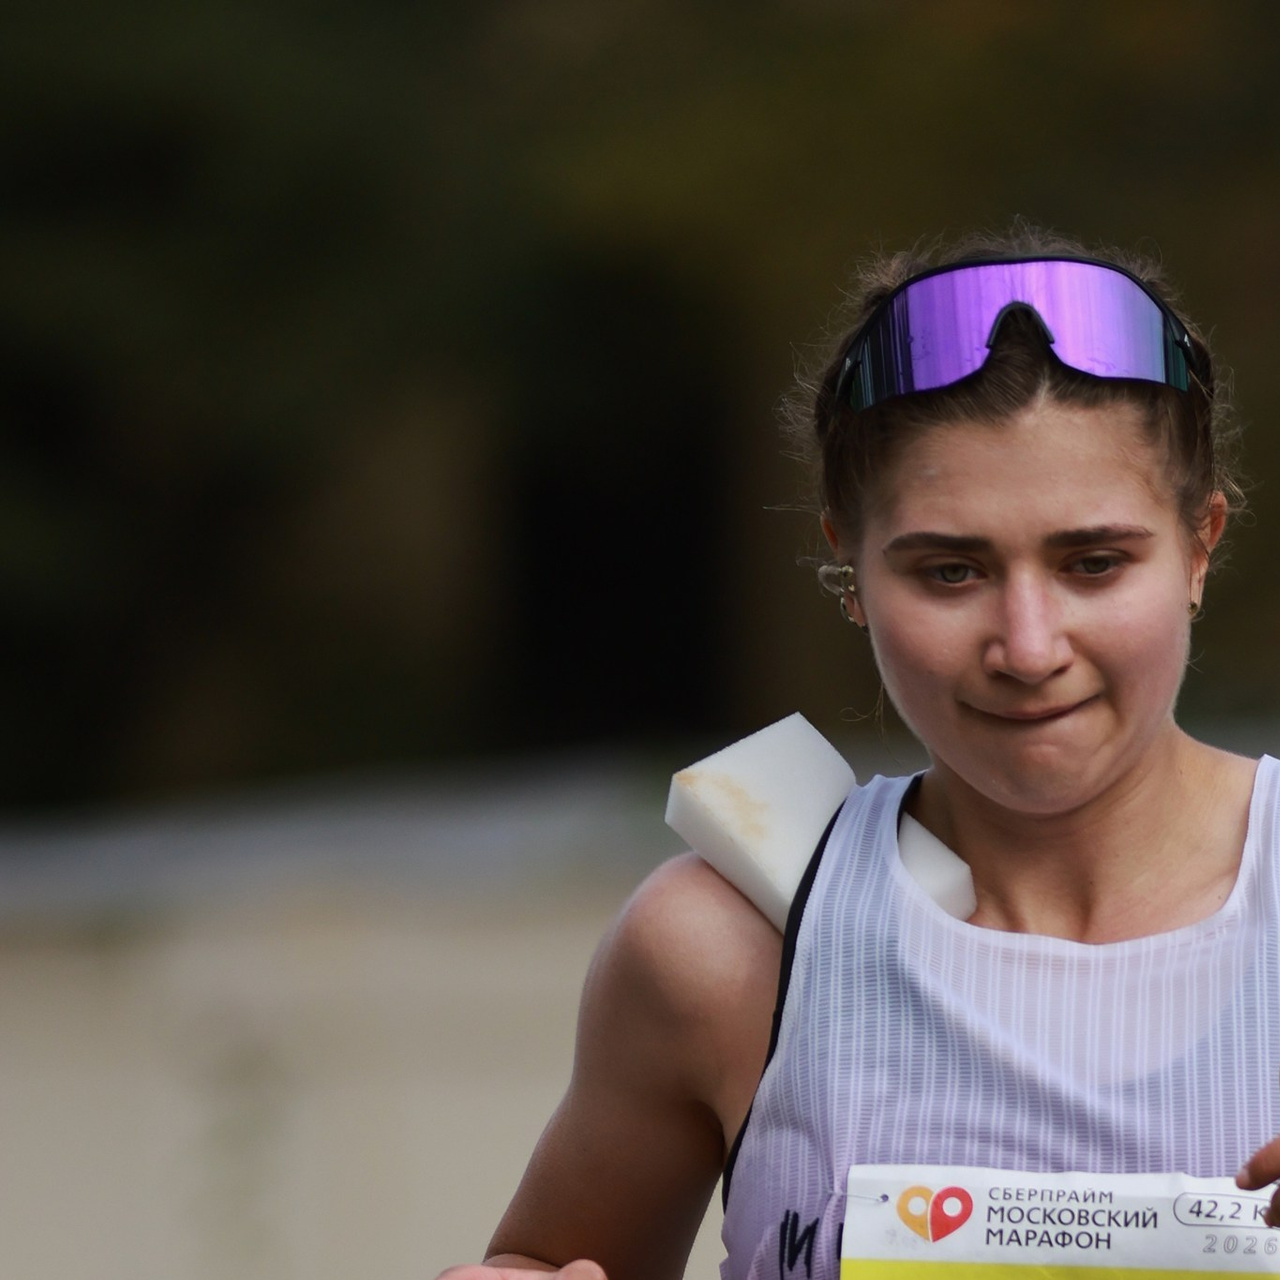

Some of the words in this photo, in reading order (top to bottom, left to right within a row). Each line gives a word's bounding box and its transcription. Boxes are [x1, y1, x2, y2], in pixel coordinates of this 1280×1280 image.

[987, 1186, 1114, 1204] СБЕРПРАЙМ
[986, 1205, 1159, 1230] МОСКОВСКИЙ
[1188, 1199, 1242, 1221] 42,2
[985, 1227, 1112, 1250] МАРАФОН
[1202, 1233, 1278, 1255] 2026
